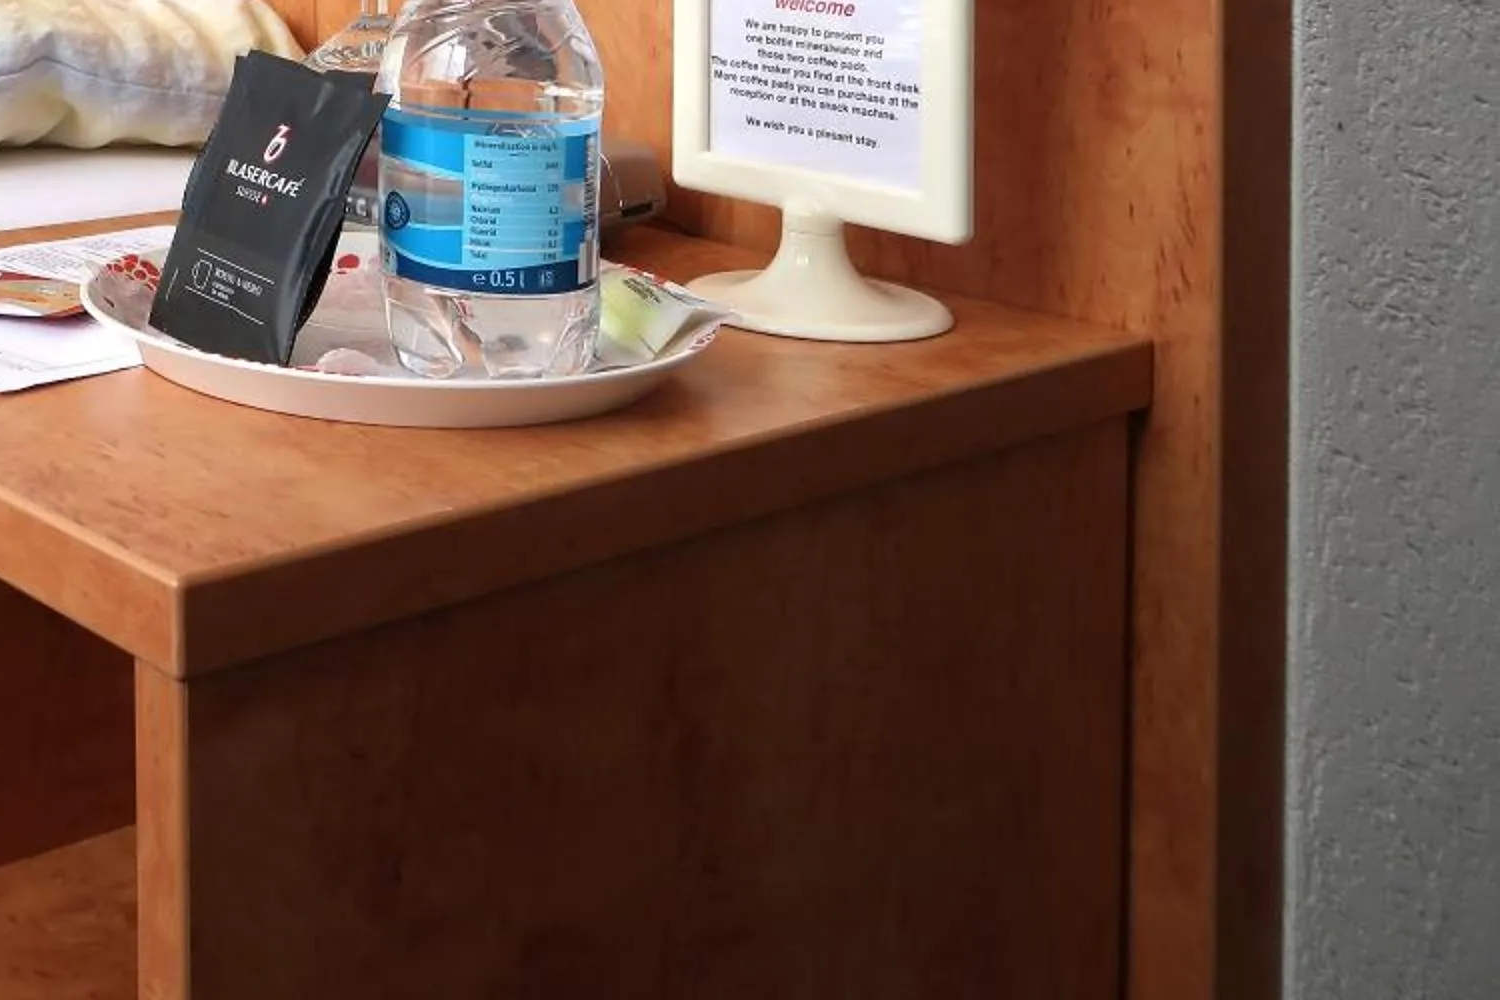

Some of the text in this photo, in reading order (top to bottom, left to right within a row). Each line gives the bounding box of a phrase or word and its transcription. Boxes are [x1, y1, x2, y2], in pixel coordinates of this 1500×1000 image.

[743, 17, 760, 29] We
[761, 22, 777, 32] are
[779, 23, 809, 37] happy
[811, 27, 822, 38] to
[823, 29, 863, 42] present
[745, 34, 763, 44] one
[765, 35, 794, 48] bottle
[863, 49, 884, 60] and
[711, 55, 728, 67] The
[729, 59, 760, 71] coffee
[793, 68, 812, 79] you
[813, 69, 833, 82] find
[835, 73, 846, 84] at
[847, 74, 865, 87] the
[786, 52, 806, 63] two
[807, 56, 839, 70] coffee
[729, 87, 775, 101] reception
[775, 94, 788, 103] or
[789, 95, 800, 106] at
[801, 96, 817, 109] the
[739, 74, 769, 87] coffee
[771, 79, 796, 91] pads
[796, 83, 816, 94] you
[817, 86, 835, 97] can
[837, 89, 886, 105] purchase
[888, 96, 899, 107] at
[745, 114, 762, 128] We
[763, 119, 786, 131] wish
[787, 123, 806, 135] you
[490, 270, 515, 287] 0.5
